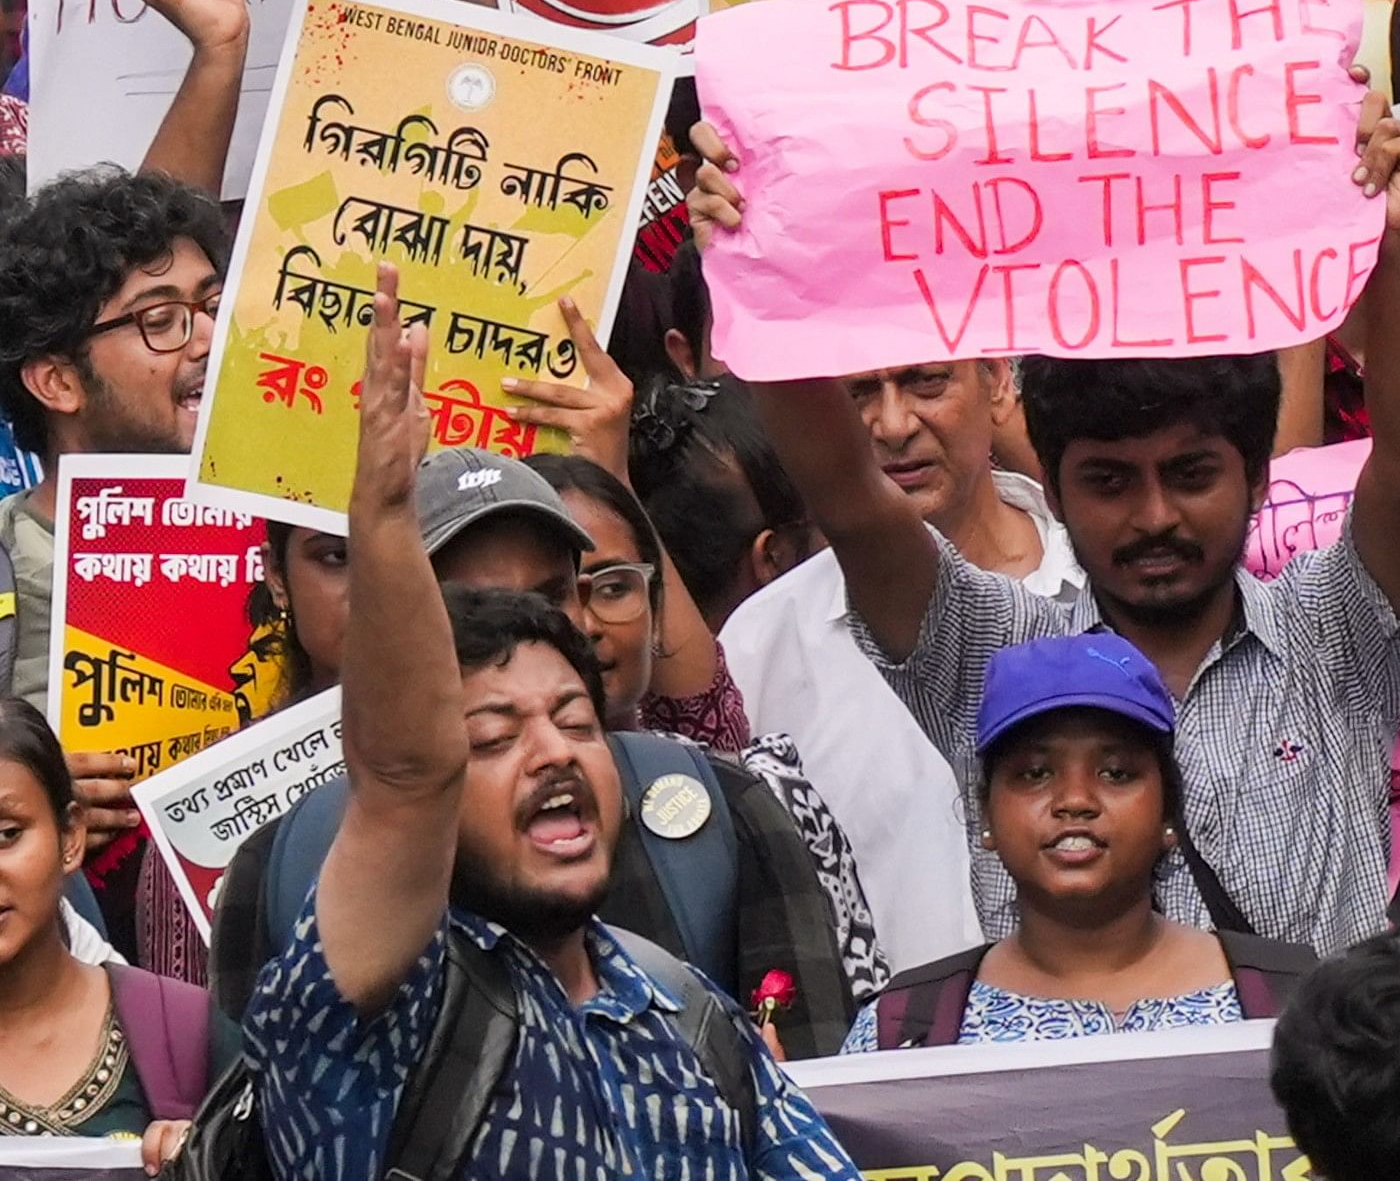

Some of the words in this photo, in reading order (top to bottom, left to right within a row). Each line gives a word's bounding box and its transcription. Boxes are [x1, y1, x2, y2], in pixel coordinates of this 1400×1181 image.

[342, 6, 382, 34] WEST
[386, 16, 441, 47] BENGAL
[445, 29, 499, 58] JUNIOR
[500, 39, 571, 76] DOCTORS'
[573, 57, 624, 87] FRONT
[304, 93, 490, 190] গিরগিটি
[500, 153, 614, 220] নাকি
[903, 60, 1339, 166] SILENCE
[334, 196, 450, 268] বোঝা
[460, 221, 530, 297] দায়,
[877, 176, 1044, 264] END
[1077, 169, 1245, 249] THE
[913, 236, 1380, 356] VIOLENCE
[257, 351, 329, 416] রং
[445, 309, 582, 375] চাদরও
[76, 485, 155, 540] পুলিশ
[161, 494, 253, 531] তোমার
[73, 552, 154, 588] কথায়
[159, 552, 239, 588] কথায়
[63, 648, 165, 728] পুলিশ
[164, 790, 209, 824] তথ্য
[212, 760, 266, 802] প্রমাণ
[273, 729, 330, 774] খেলে
